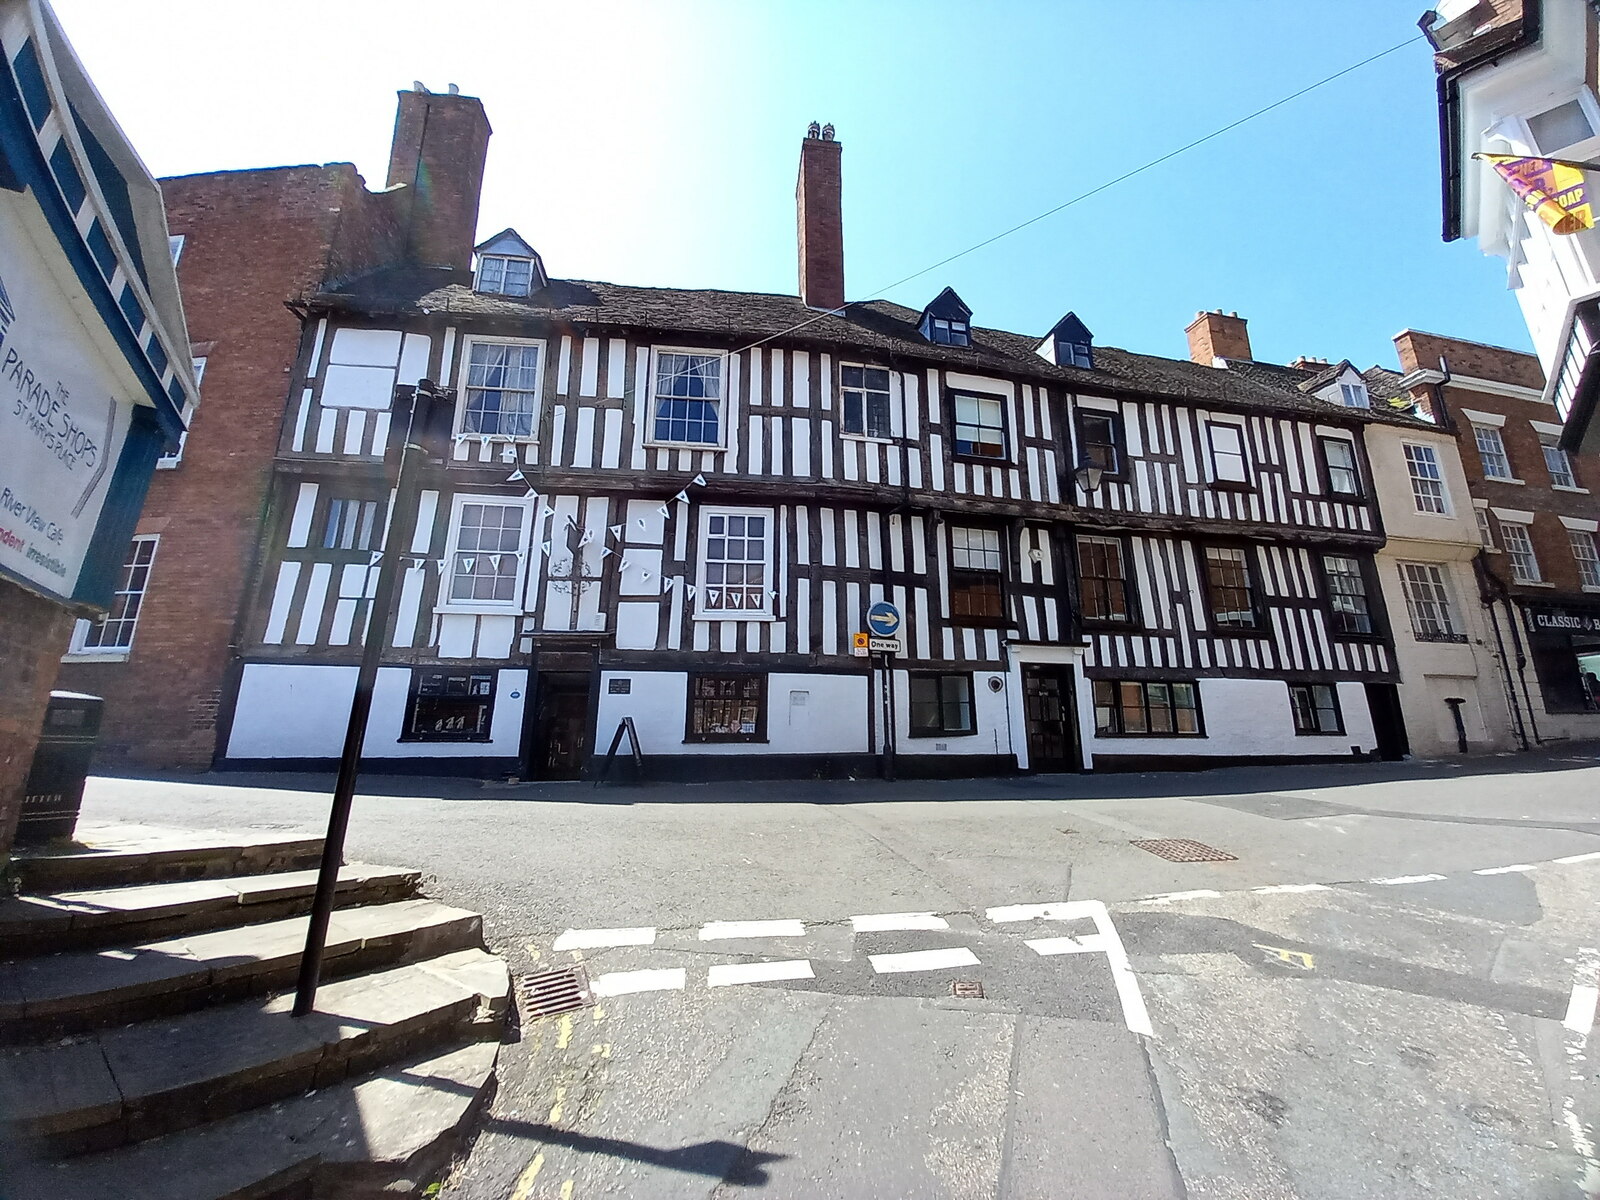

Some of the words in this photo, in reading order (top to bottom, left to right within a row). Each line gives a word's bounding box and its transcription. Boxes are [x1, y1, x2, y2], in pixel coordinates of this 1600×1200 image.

[57, 381, 70, 406] THE
[2, 347, 60, 428] PARADE
[58, 413, 97, 468] SHOPS
[13, 399, 28, 420] ST
[1, 487, 26, 518] River
[25, 506, 46, 533] View
[1537, 615, 1581, 628] CLASSIC
